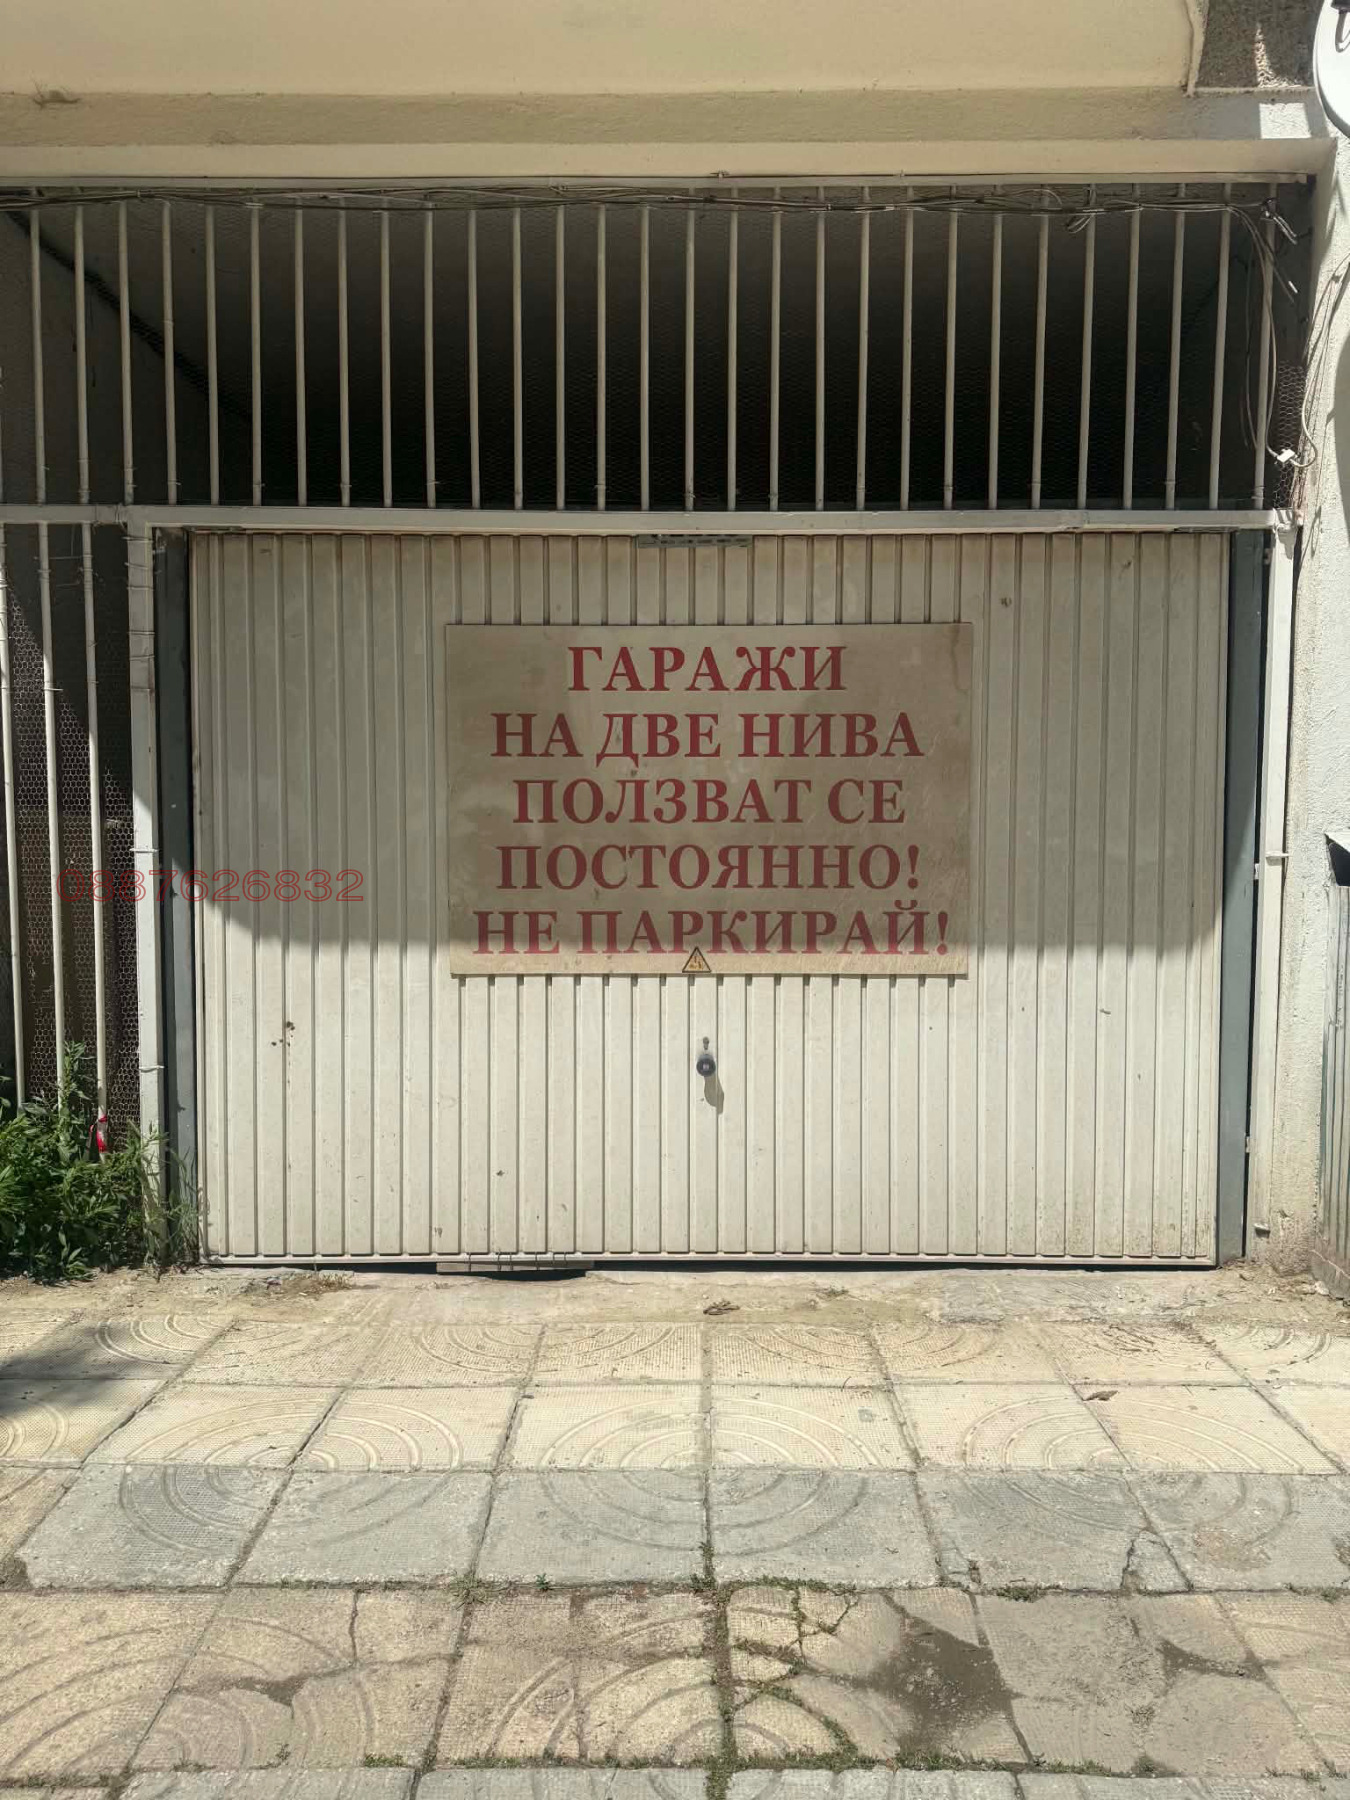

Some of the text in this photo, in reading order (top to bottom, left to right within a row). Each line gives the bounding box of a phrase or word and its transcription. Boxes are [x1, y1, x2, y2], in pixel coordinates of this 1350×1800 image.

[567, 646, 845, 693] ГАРАЖИ
[490, 712, 925, 768] НА ДВЕ НИВА
[512, 778, 906, 824] ПОЛЗВАТ СЕ
[496, 844, 920, 890] ПОСТОЯННО!
[472, 900, 950, 956] НЕ ПАРКИРАЙ!
